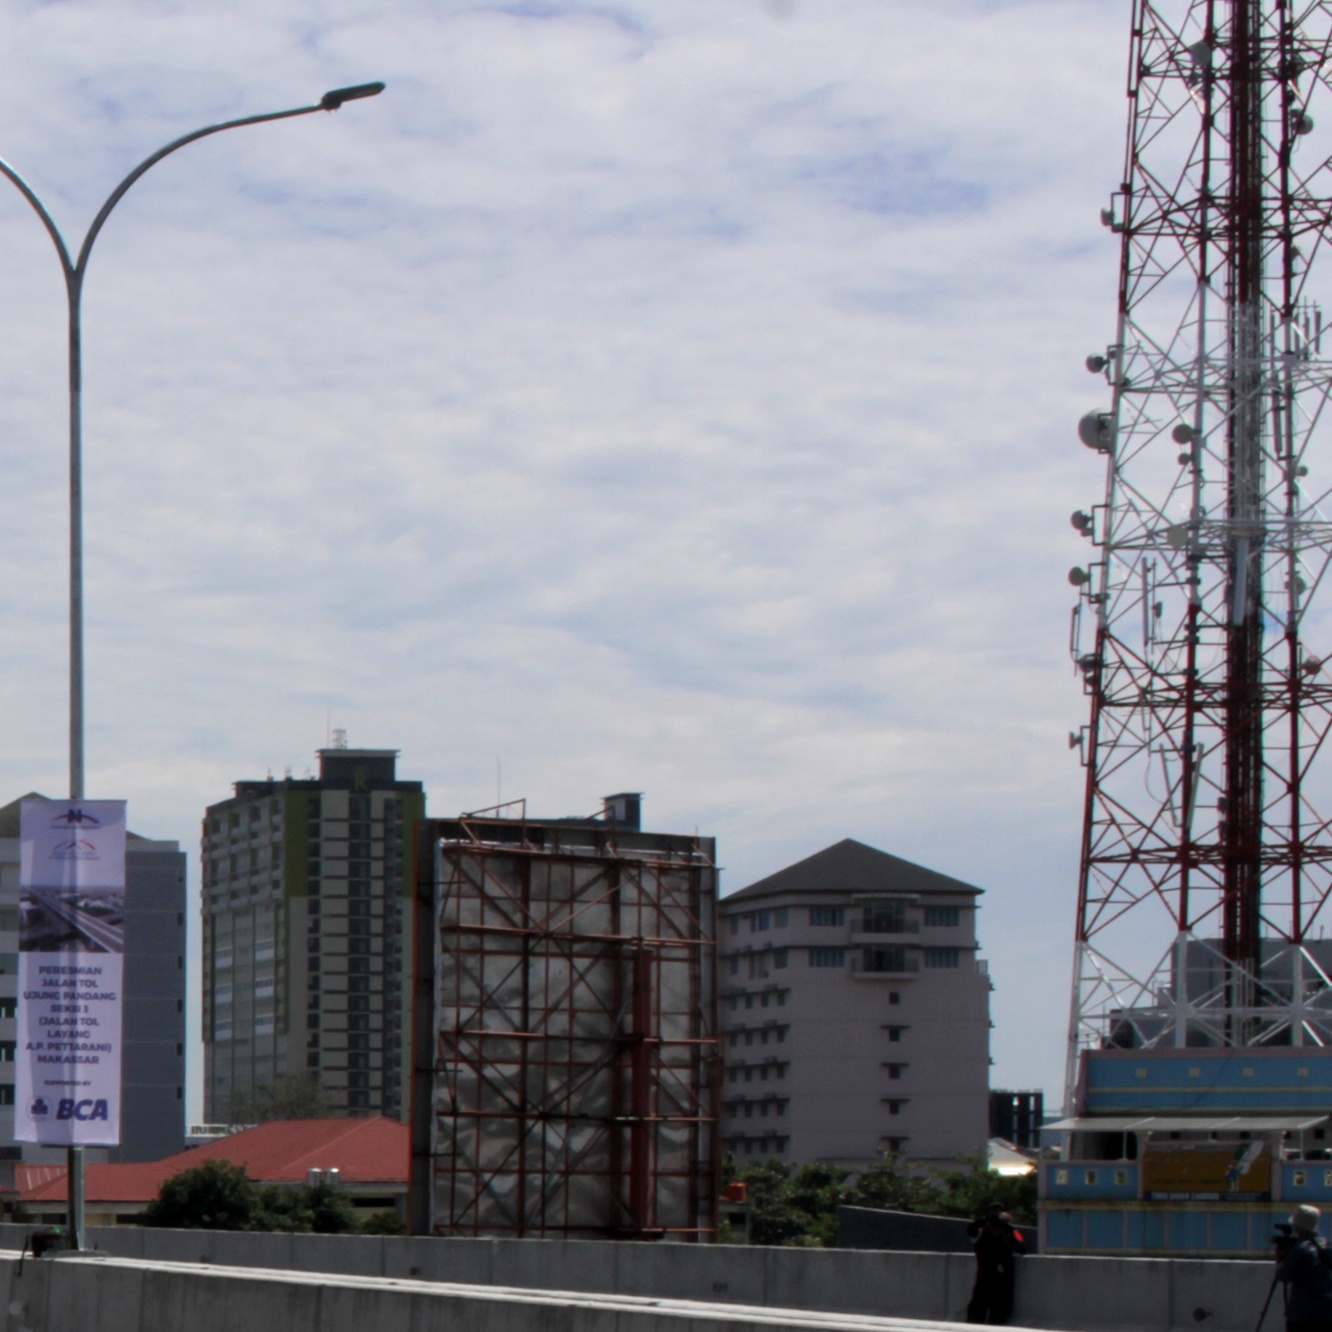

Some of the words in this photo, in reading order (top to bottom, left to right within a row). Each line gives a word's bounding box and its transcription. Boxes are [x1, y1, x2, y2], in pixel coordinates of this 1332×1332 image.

[38, 966, 102, 975] PERESMIAN
[41, 979, 77, 988] JALAN
[79, 979, 98, 988] TOL
[24, 991, 61, 1000] UJUNG
[63, 992, 116, 1001] PANDANG
[50, 1004, 81, 1013] SEKSI
[38, 1016, 77, 1026] (JALAN
[80, 1018, 99, 1026] TOL
[47, 1030, 91, 1039] LAYANG
[47, 1042, 112, 1053] PETTARANI)
[37, 1055, 99, 1064] MAKASSAR
[56, 1098, 108, 1121] BCA
